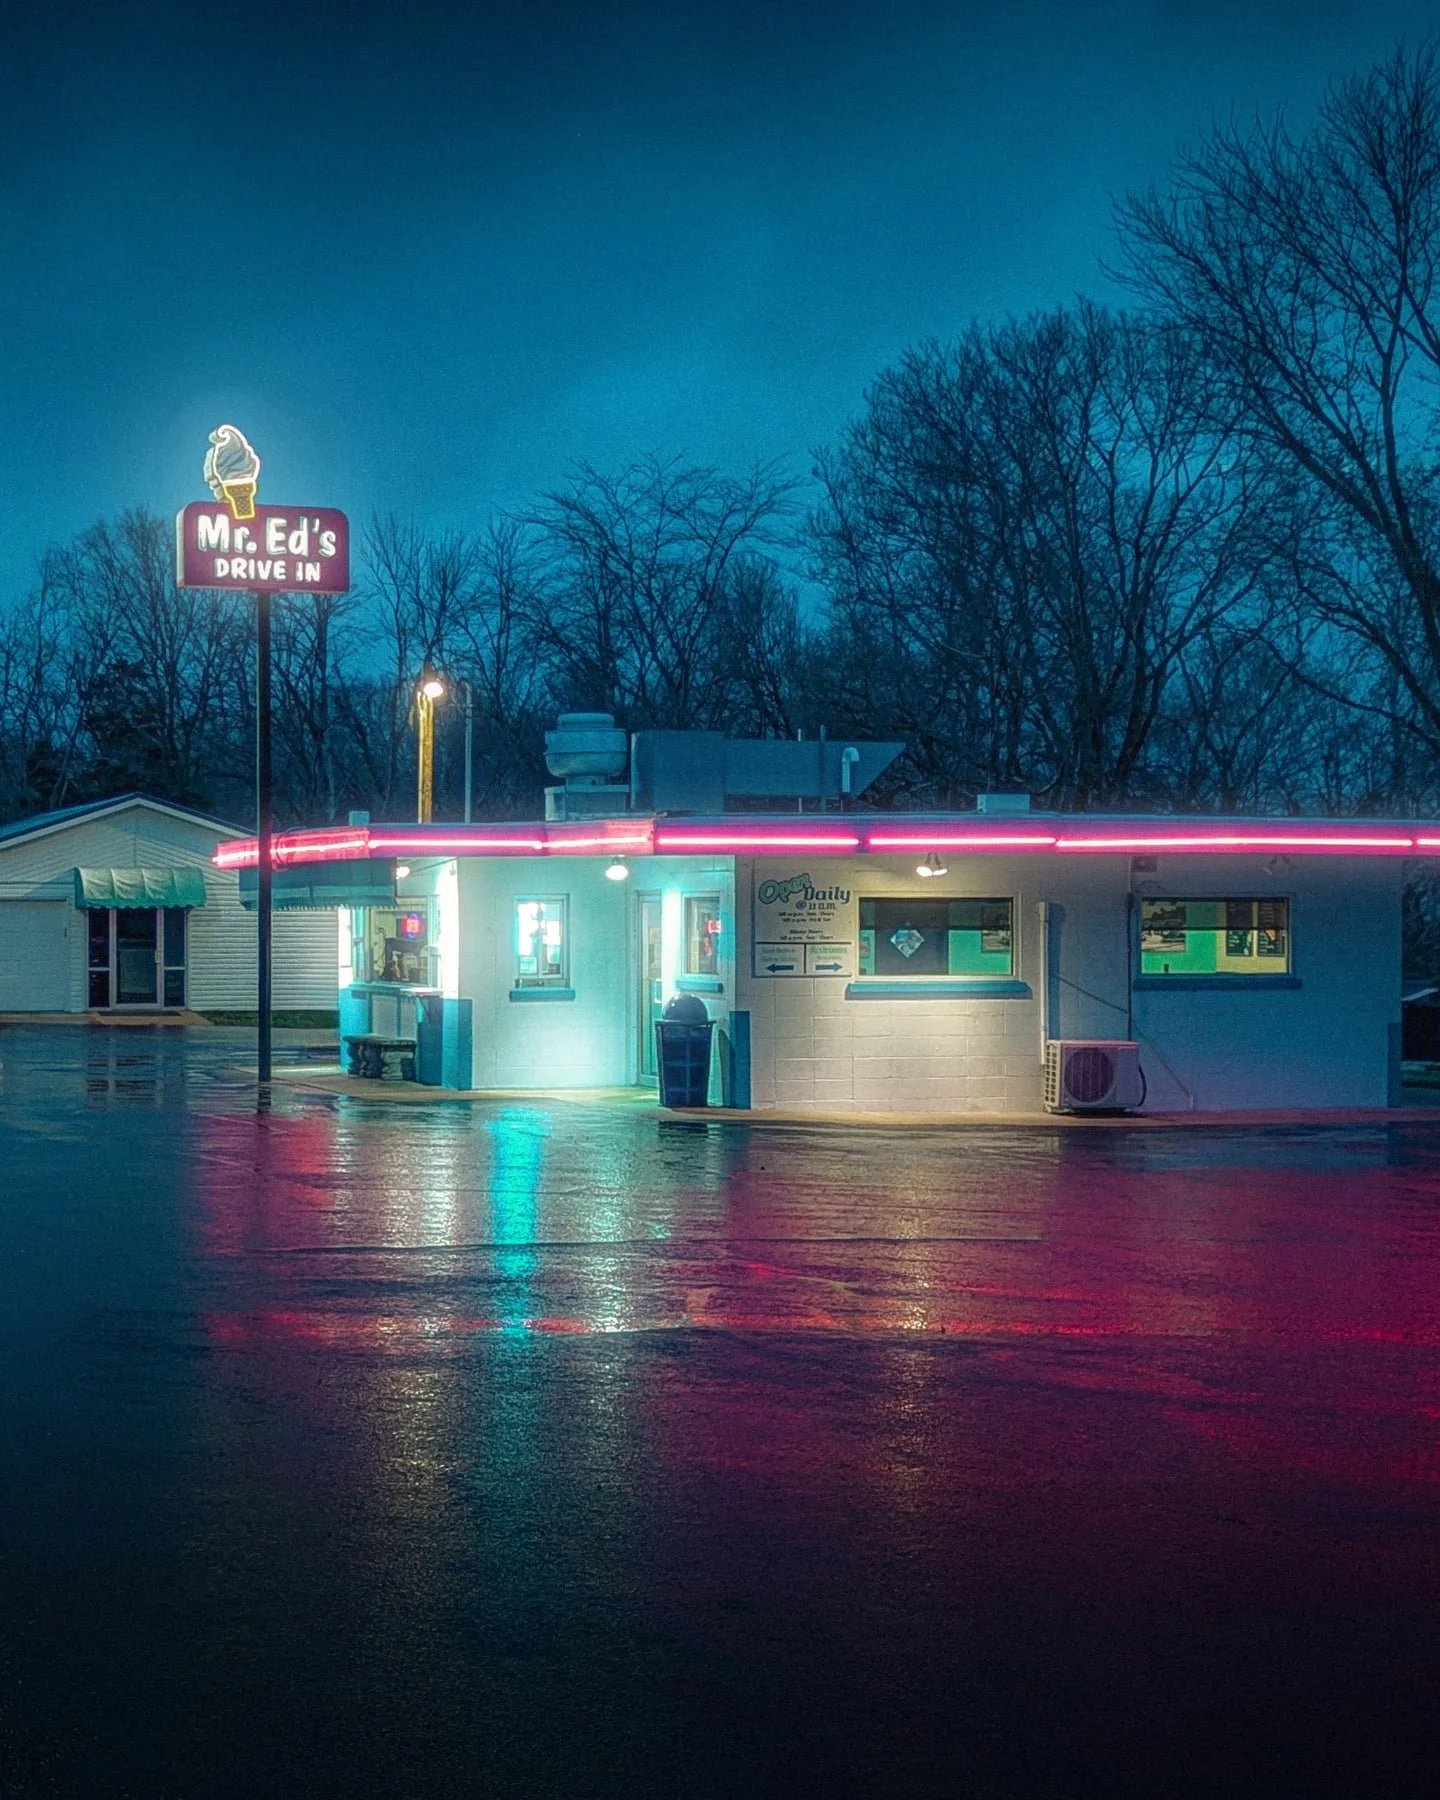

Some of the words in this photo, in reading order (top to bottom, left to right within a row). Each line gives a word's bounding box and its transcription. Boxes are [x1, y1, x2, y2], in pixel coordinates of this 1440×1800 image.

[197, 513, 257, 554] Mr.
[266, 516, 336, 558] Ed's
[215, 557, 287, 581] DRIVE
[296, 561, 321, 582] IN
[758, 872, 812, 905] Open
[803, 886, 851, 904] Daily
